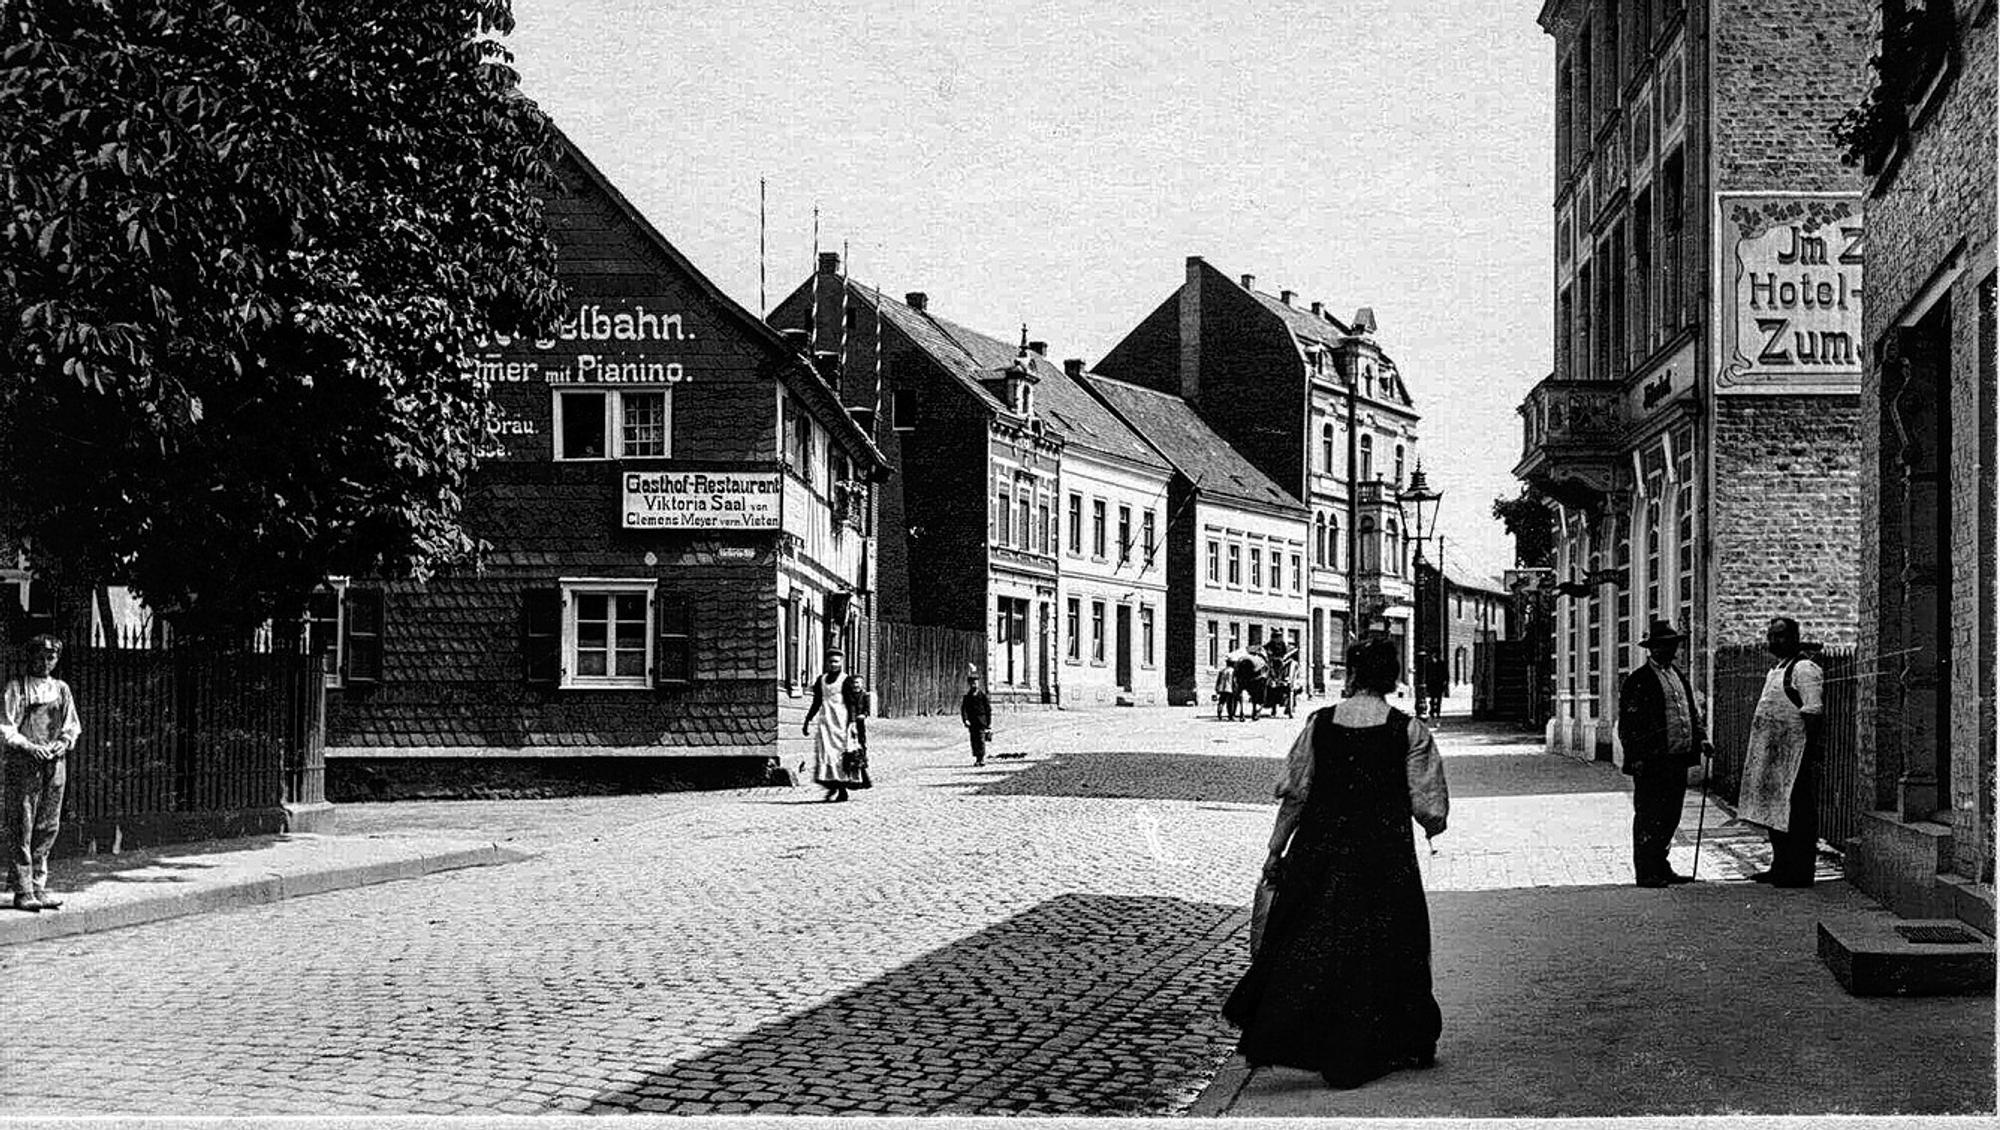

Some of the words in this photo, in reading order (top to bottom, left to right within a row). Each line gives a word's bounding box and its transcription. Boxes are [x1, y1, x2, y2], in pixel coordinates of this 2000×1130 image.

[1838, 227, 1864, 265] Z
[1750, 271, 1863, 310] Hotel-
[1756, 318, 1856, 365] Zum
[545, 365, 570, 382] mit
[577, 354, 693, 383] Pianino.
[626, 474, 780, 494] Gasthof-Restaurant
[643, 495, 707, 511] Viktoria
[711, 494, 746, 511] Saal
[750, 503, 768, 511] von
[626, 512, 679, 526] Clemens
[681, 513, 718, 527] Meyer
[742, 513, 778, 526] Vieten
